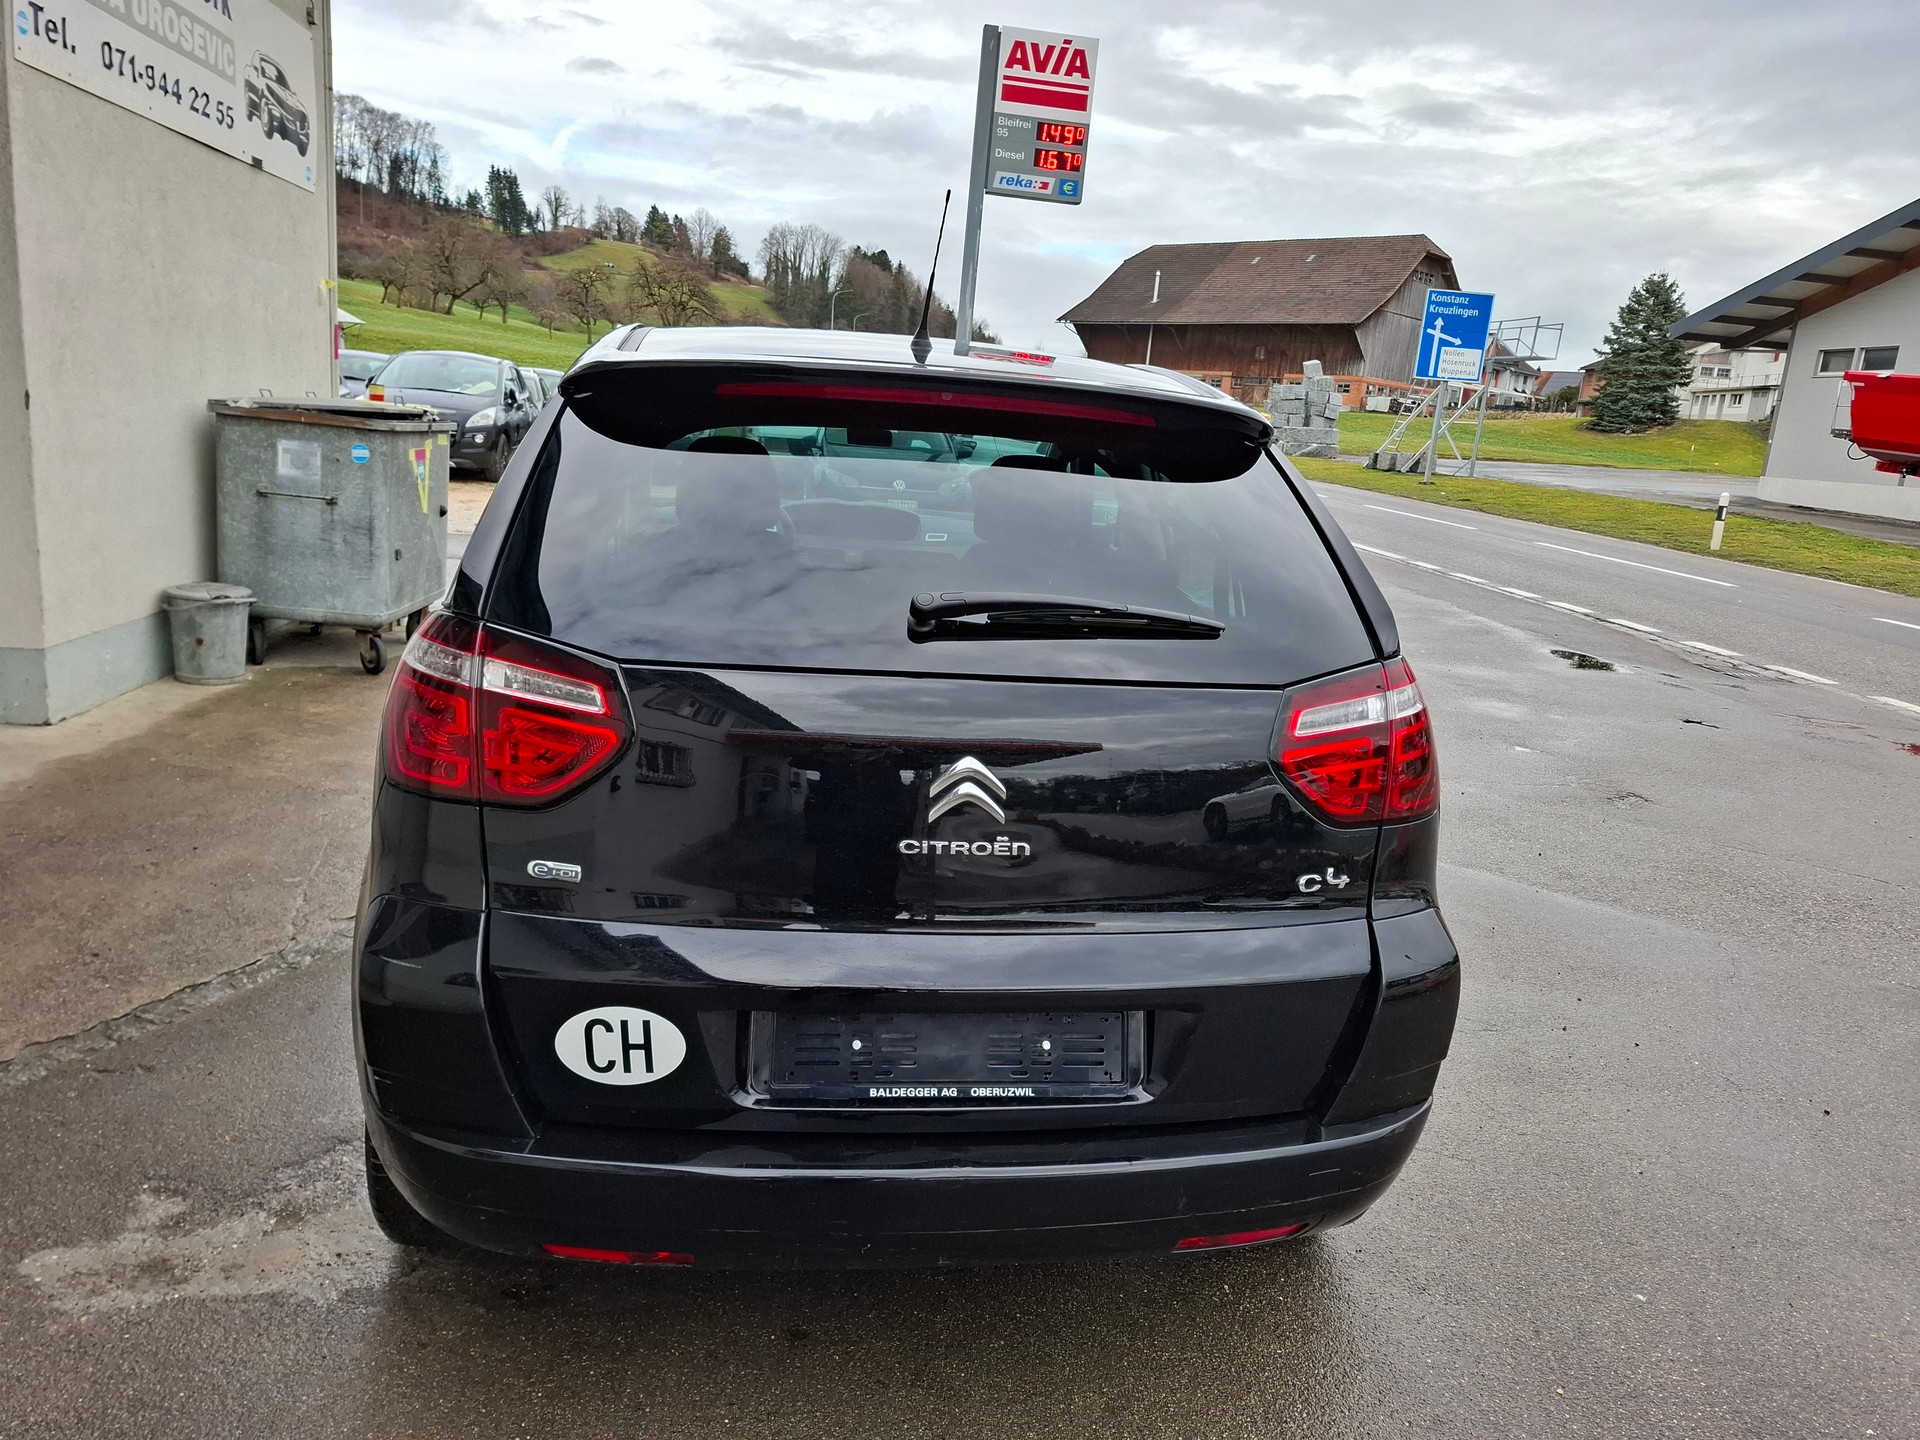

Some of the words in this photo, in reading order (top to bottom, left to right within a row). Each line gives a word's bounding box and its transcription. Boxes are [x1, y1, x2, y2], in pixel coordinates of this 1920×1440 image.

[28, 1, 76, 54] Tel.
[189, 86, 210, 119] 22
[216, 101, 235, 129] 55
[1004, 39, 1090, 79] AVIA
[998, 117, 1032, 129] Bleifrei
[997, 128, 1009, 137] 95
[995, 148, 1025, 160] Diesel
[1431, 292, 1470, 305] Konstanz
[1429, 304, 1479, 318] Kreuzlingen
[1443, 349, 1465, 358] Nollen
[1441, 359, 1477, 368] Hosenruck
[1440, 367, 1476, 377] Wuppenau
[1299, 867, 1350, 893] C4
[584, 1018, 654, 1074] CH
[869, 1087, 938, 1097] BALDEGGER
[941, 1087, 958, 1097] AG
[970, 1087, 1035, 1097] OBERUZWIL
